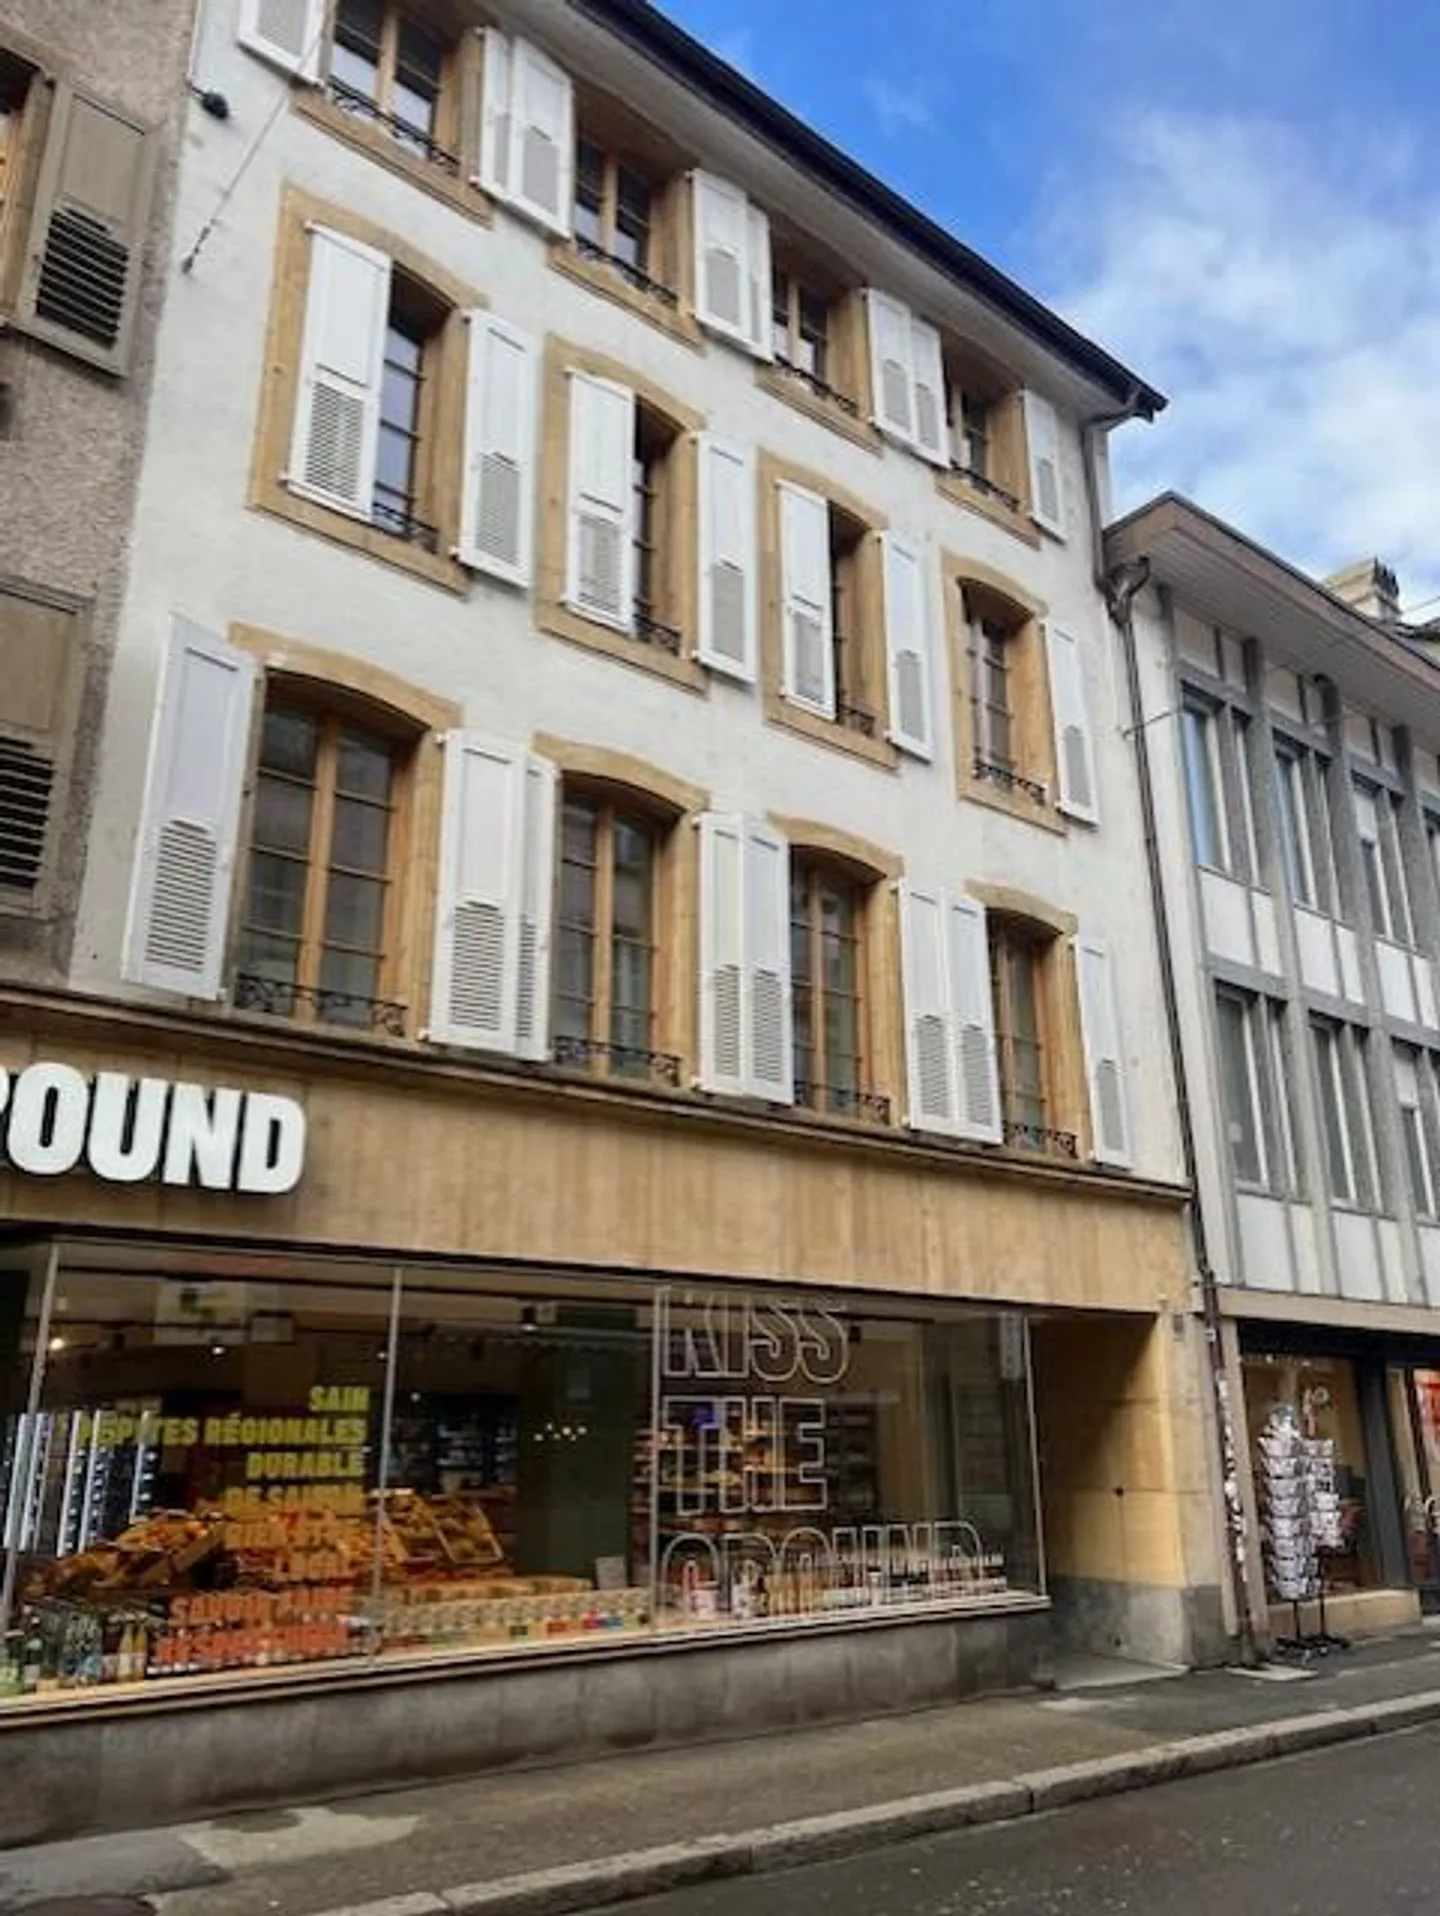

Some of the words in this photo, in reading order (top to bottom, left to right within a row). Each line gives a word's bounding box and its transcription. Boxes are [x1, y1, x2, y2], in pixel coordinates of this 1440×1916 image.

[0, 1062, 307, 1194] OUND
[663, 1286, 848, 1384] KISS
[309, 1386, 370, 1412] SAIN
[246, 1452, 364, 1478] DURABLE
[661, 1396, 828, 1516] THE
